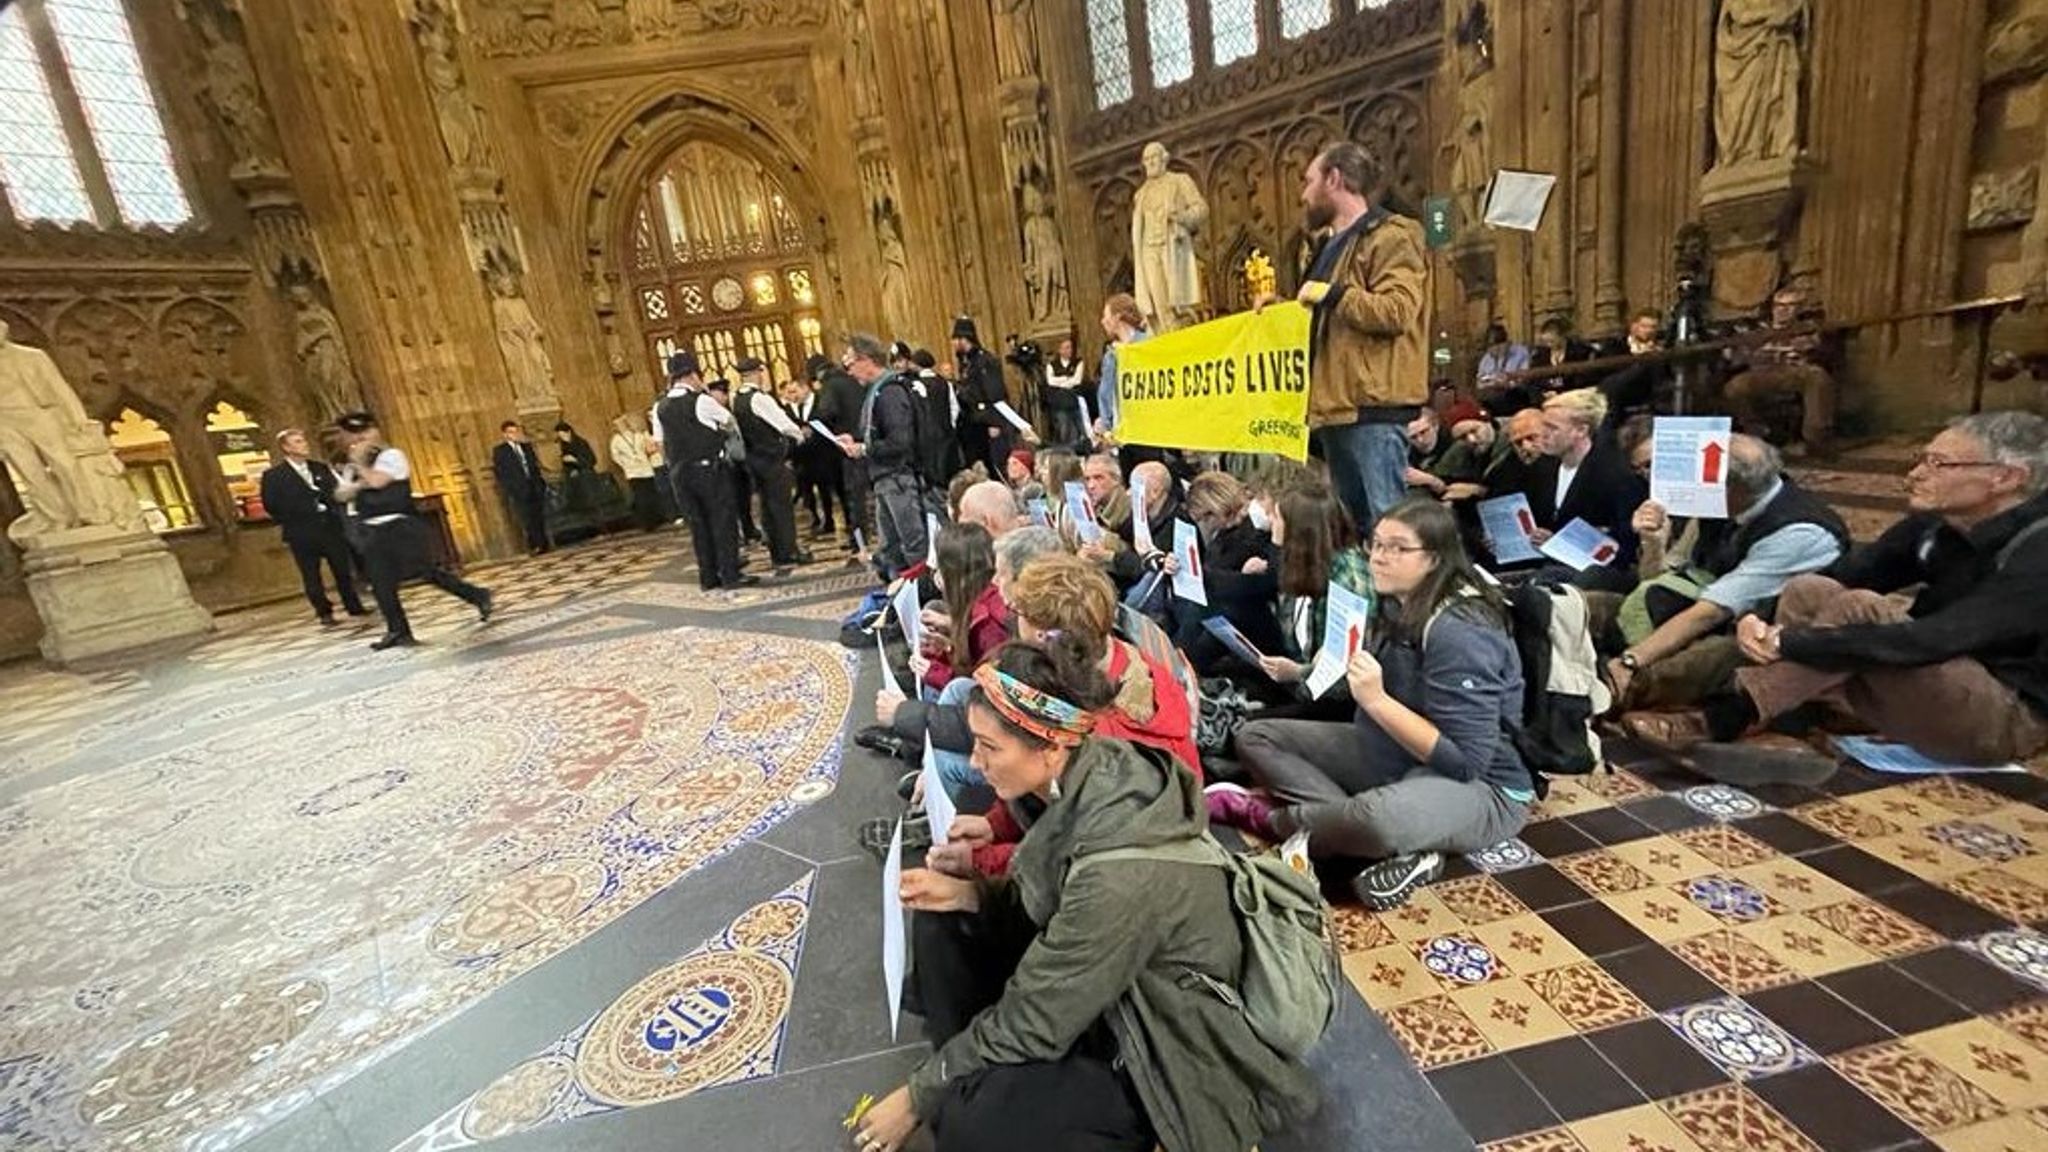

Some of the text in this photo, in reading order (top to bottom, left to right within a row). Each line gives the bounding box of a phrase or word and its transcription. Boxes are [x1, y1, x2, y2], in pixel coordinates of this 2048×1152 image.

[1122, 348, 1306, 399] CHAOS COSTS LIVES
